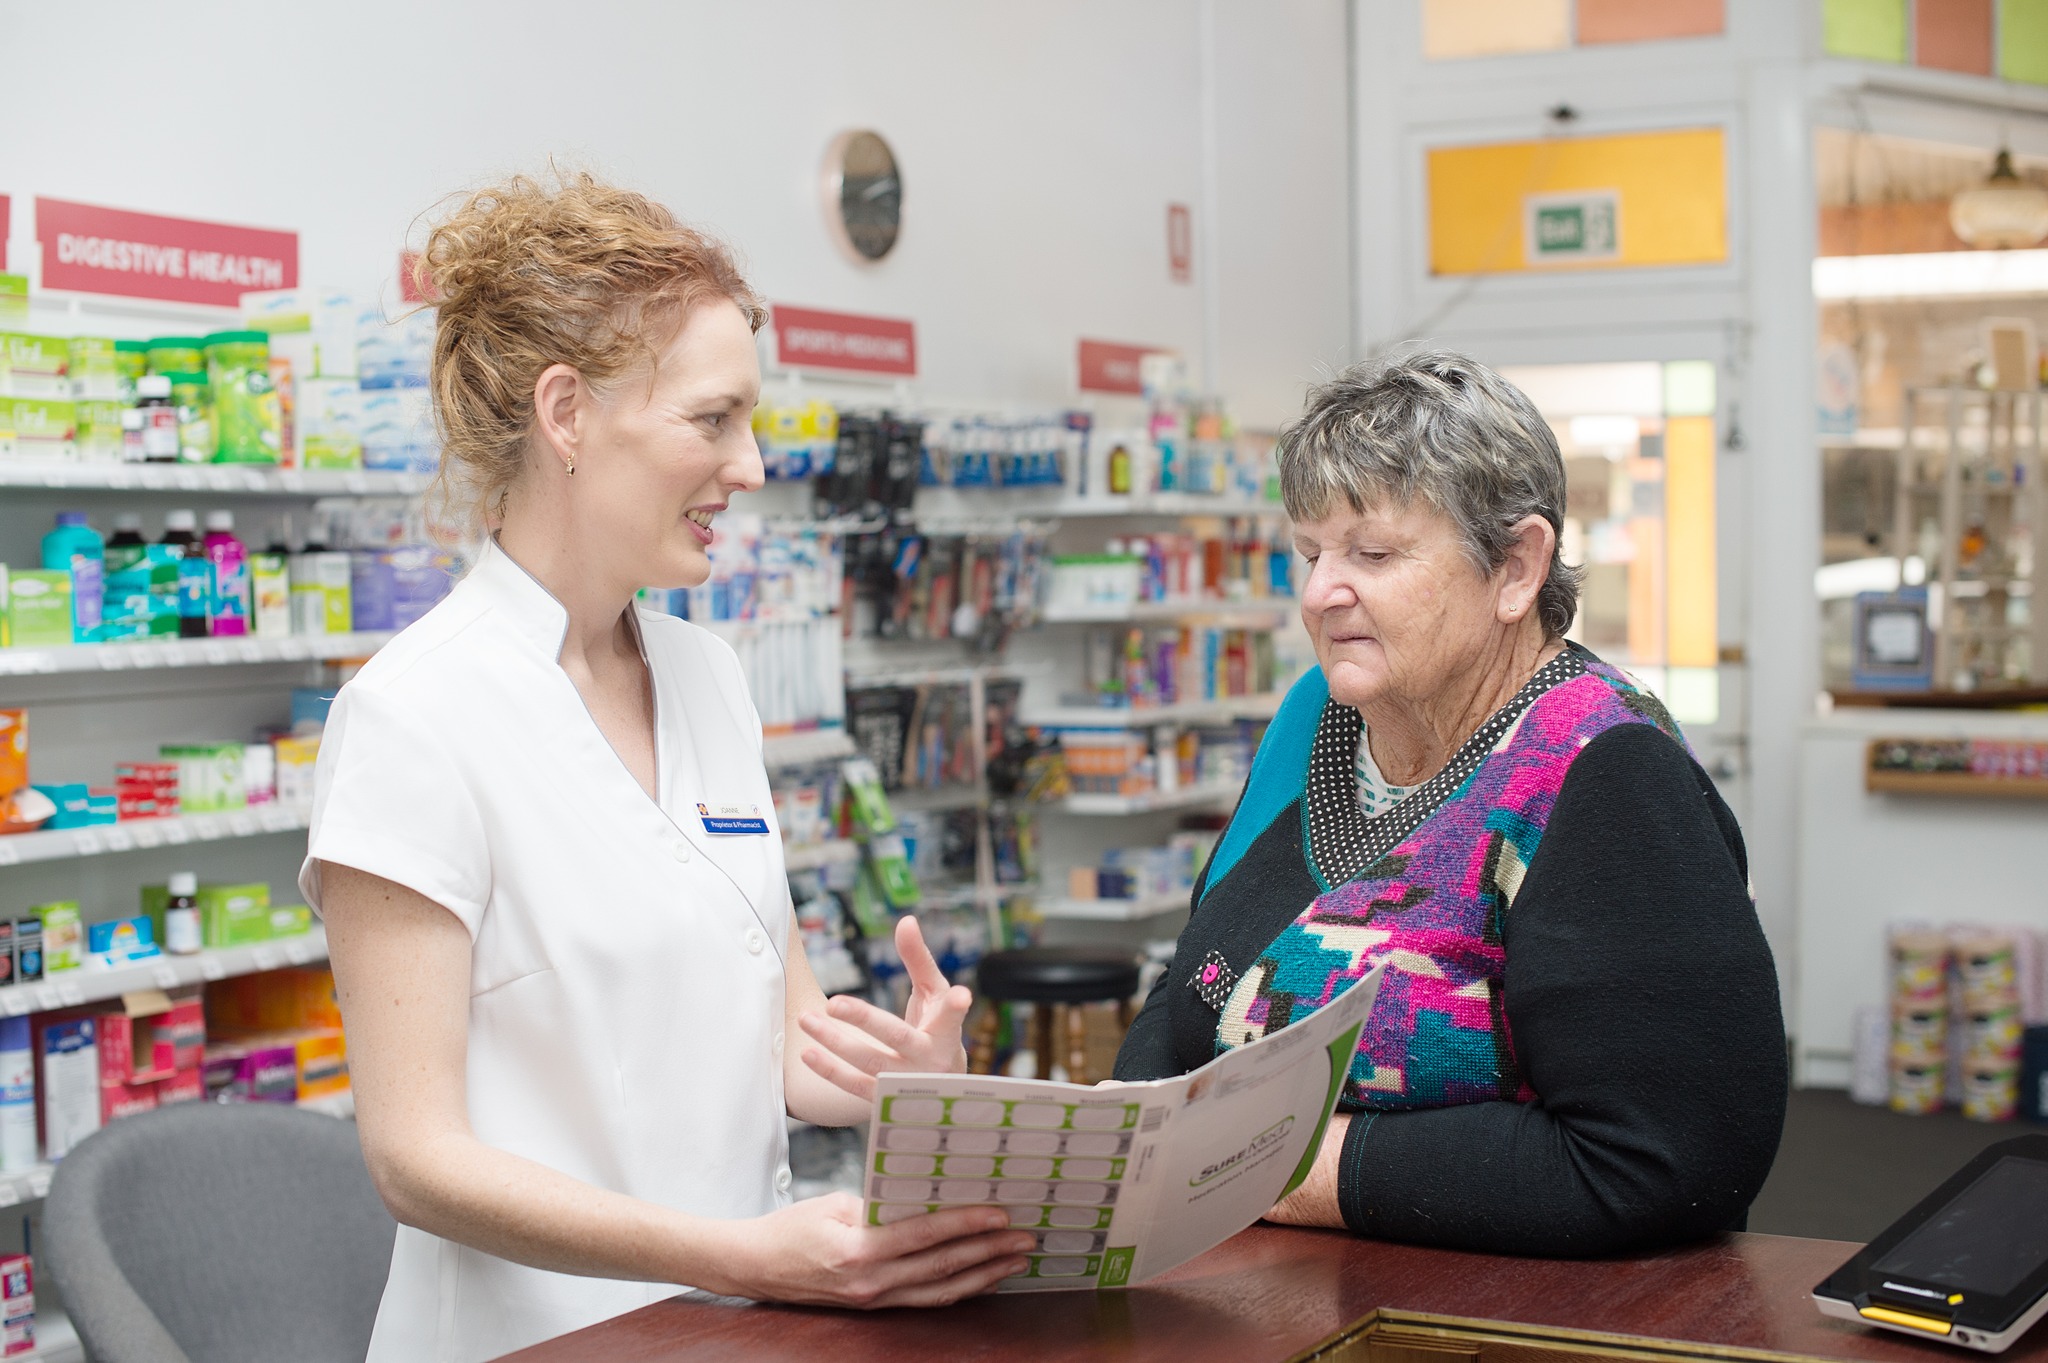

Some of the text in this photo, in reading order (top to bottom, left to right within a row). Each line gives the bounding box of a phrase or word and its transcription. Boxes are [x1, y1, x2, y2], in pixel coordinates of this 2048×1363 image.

[57, 233, 283, 288] DIGESTIVE HEALTH
[737, 821, 762, 829] Pharmacist
